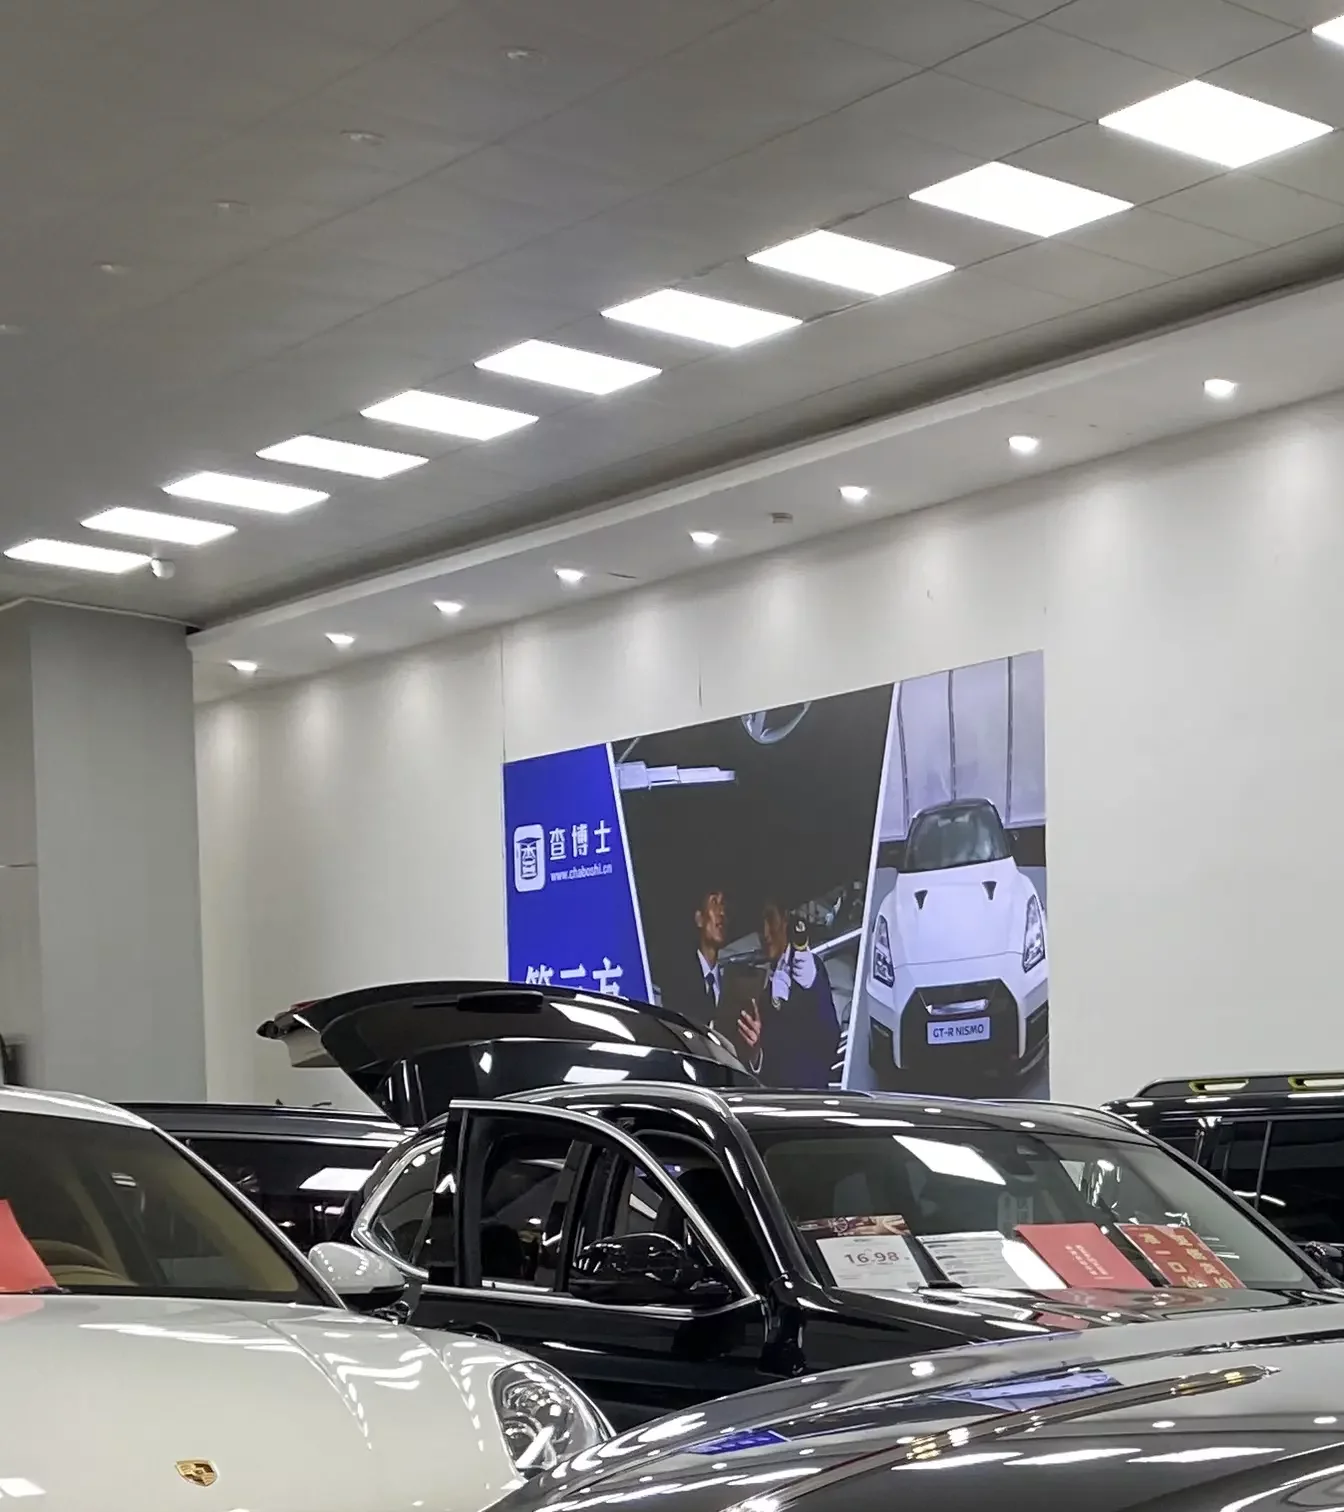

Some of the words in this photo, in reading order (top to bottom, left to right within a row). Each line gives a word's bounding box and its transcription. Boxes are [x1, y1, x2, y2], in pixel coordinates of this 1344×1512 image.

[549, 820, 611, 860] 查博士
[550, 863, 612, 881] www.chaboshi.cn
[933, 1027, 954, 1038] GT-R
[956, 1024, 984, 1036] NISMO
